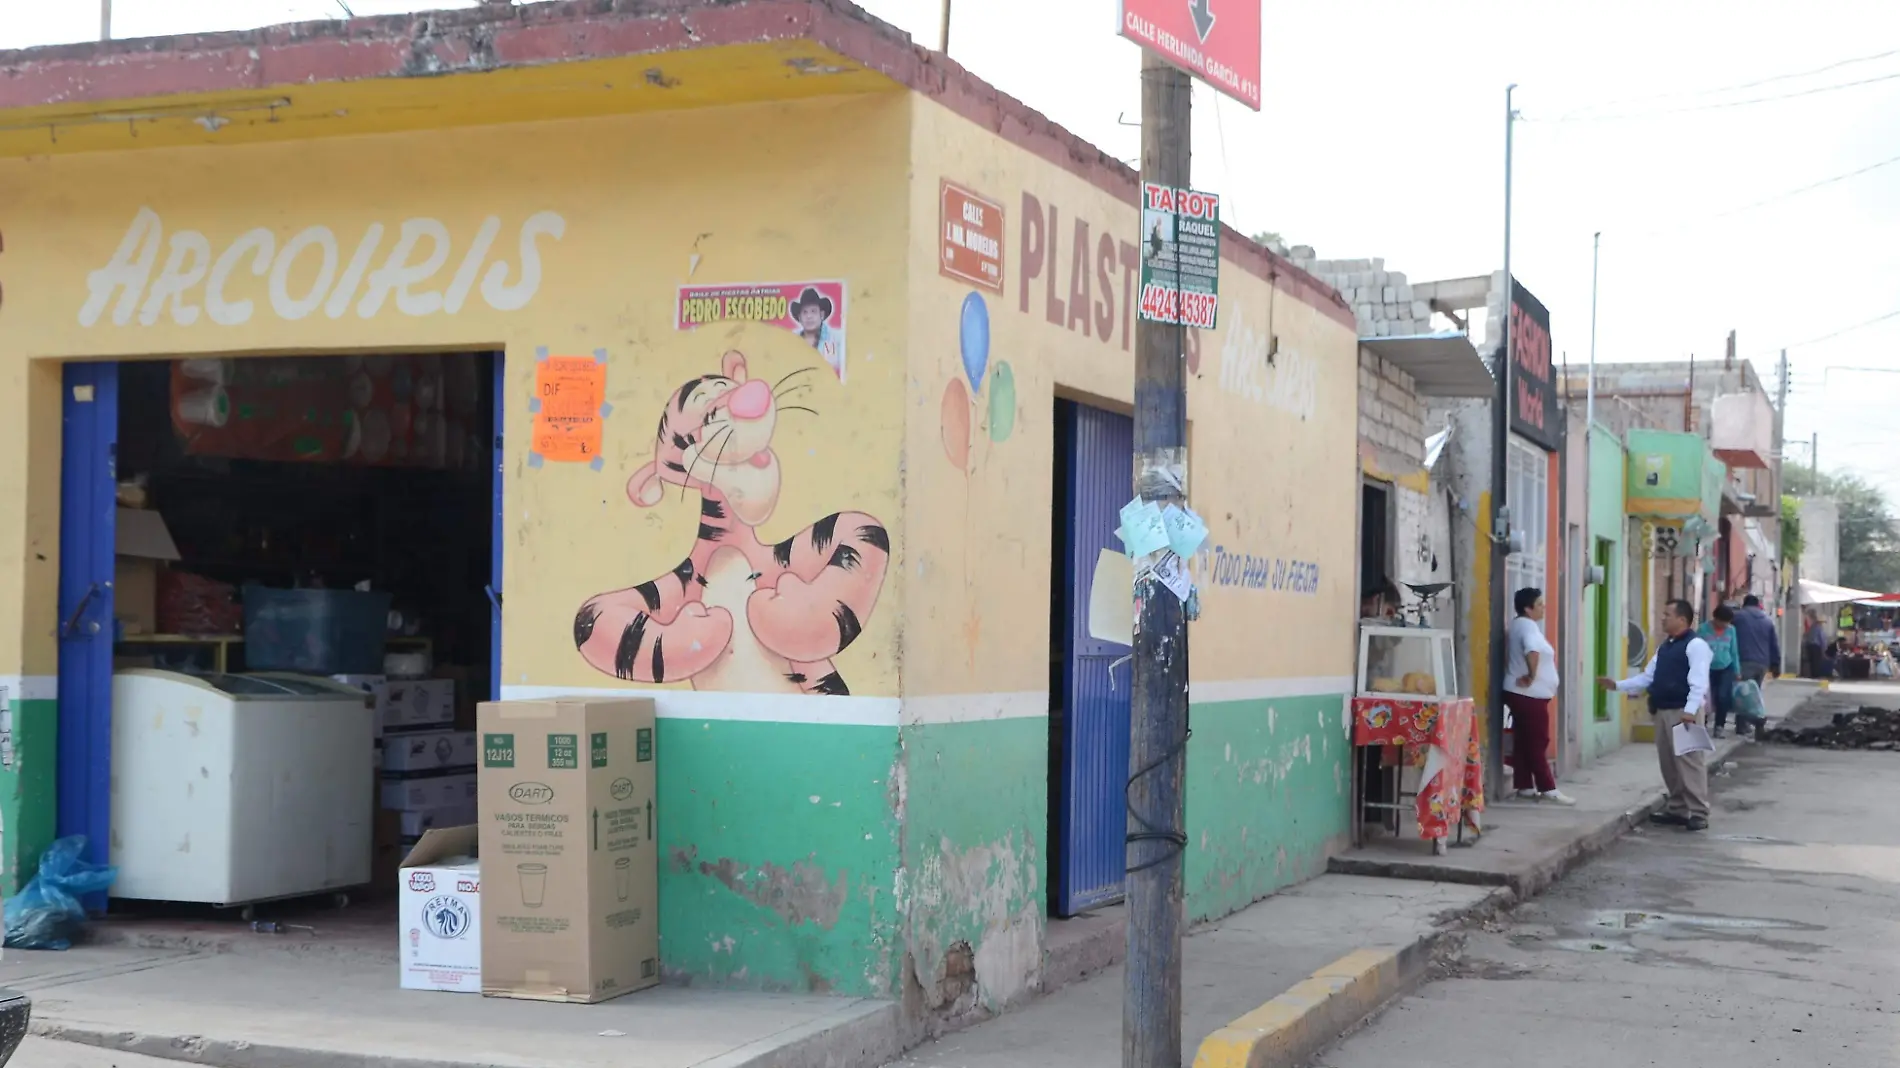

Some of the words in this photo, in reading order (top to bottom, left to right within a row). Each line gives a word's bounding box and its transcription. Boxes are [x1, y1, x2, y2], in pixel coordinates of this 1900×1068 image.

[1126, 12, 1155, 42] CALLE
[1157, 28, 1204, 69] HERLINDA
[1241, 81, 1258, 100] #15
[1146, 185, 1217, 219] TAROT
[963, 201, 983, 227] CALLE
[1179, 220, 1215, 237] RAQUEL
[77, 206, 566, 327] ARCOIRIS
[681, 298, 721, 323] PEDRO
[725, 296, 787, 322] ESCOBEDO
[1142, 285, 1215, 328] 4424345387
[1212, 545, 1240, 586] TODO
[1241, 554, 1269, 590] PARA
[1272, 558, 1286, 592] SU
[1287, 560, 1318, 594] FIESTA
[486, 748, 513, 761] 12J12
[554, 748, 563, 757] 12
[514, 787, 549, 799] DART
[494, 813, 523, 822] VASOS
[525, 813, 569, 824] TERMICOS
[508, 822, 525, 830] PARA
[412, 872, 433, 882] 1000
[428, 896, 465, 914] REYMA
